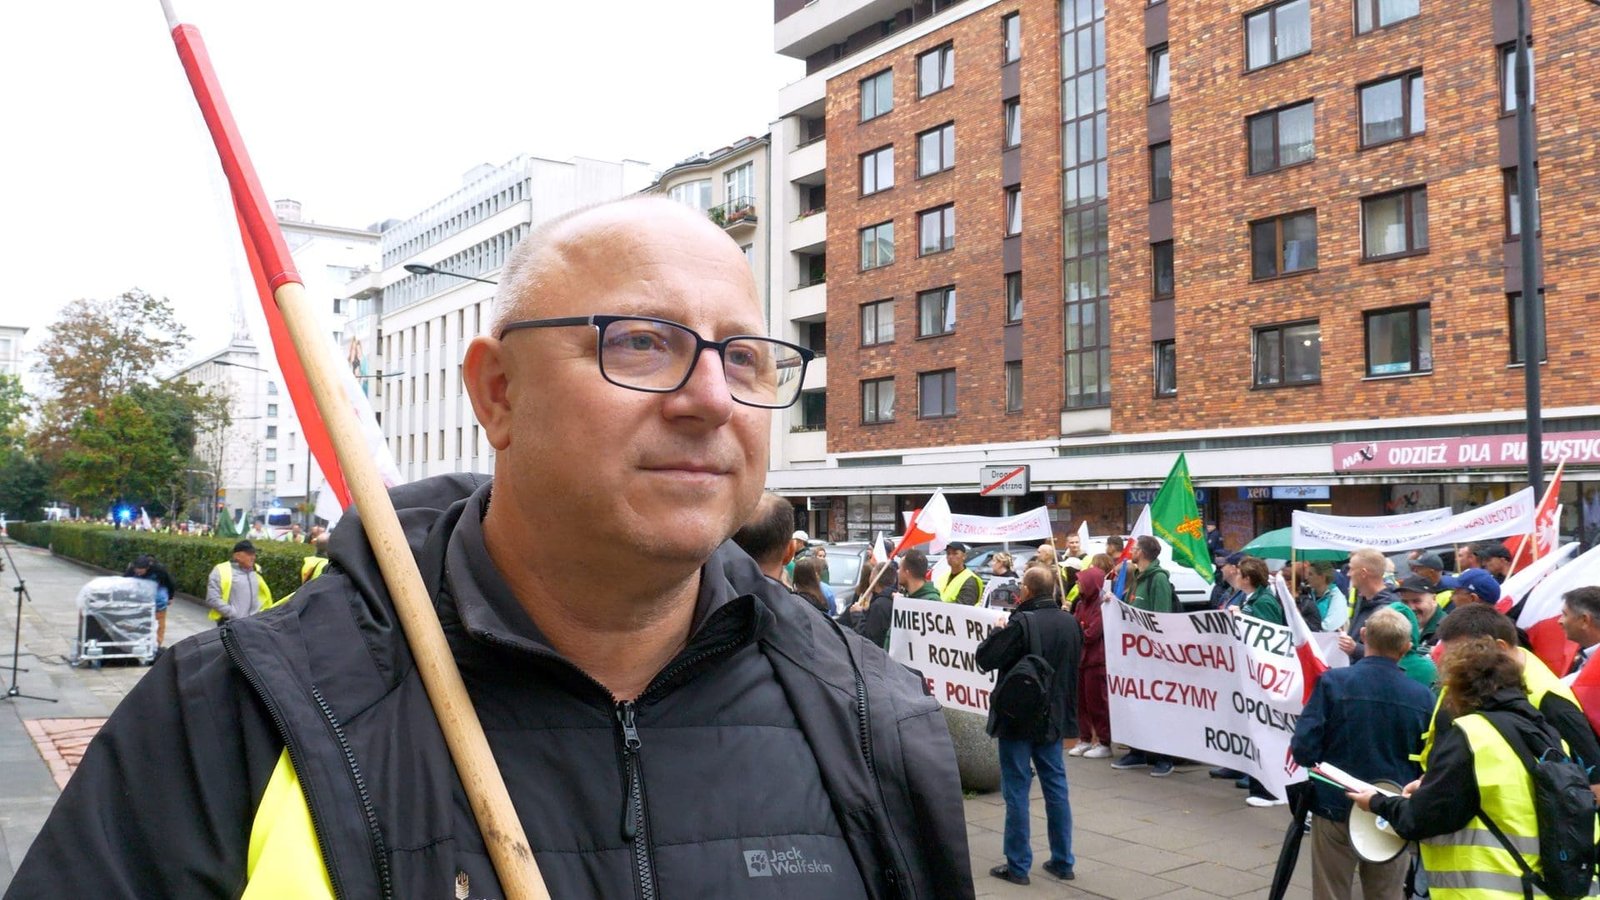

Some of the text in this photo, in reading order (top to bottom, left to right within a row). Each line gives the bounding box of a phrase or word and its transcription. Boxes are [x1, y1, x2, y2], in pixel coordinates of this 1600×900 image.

[1388, 443, 1448, 465] ODZIEŻ
[1459, 443, 1491, 463] DLA
[1247, 487, 1270, 499] xero
[893, 608, 956, 637] MIEJSCA
[908, 641, 914, 661] I
[1121, 633, 1236, 673] POSŁUCHAJ
[1107, 674, 1218, 712] WALCZYMY
[770, 846, 833, 876] Jack Wolfskin
